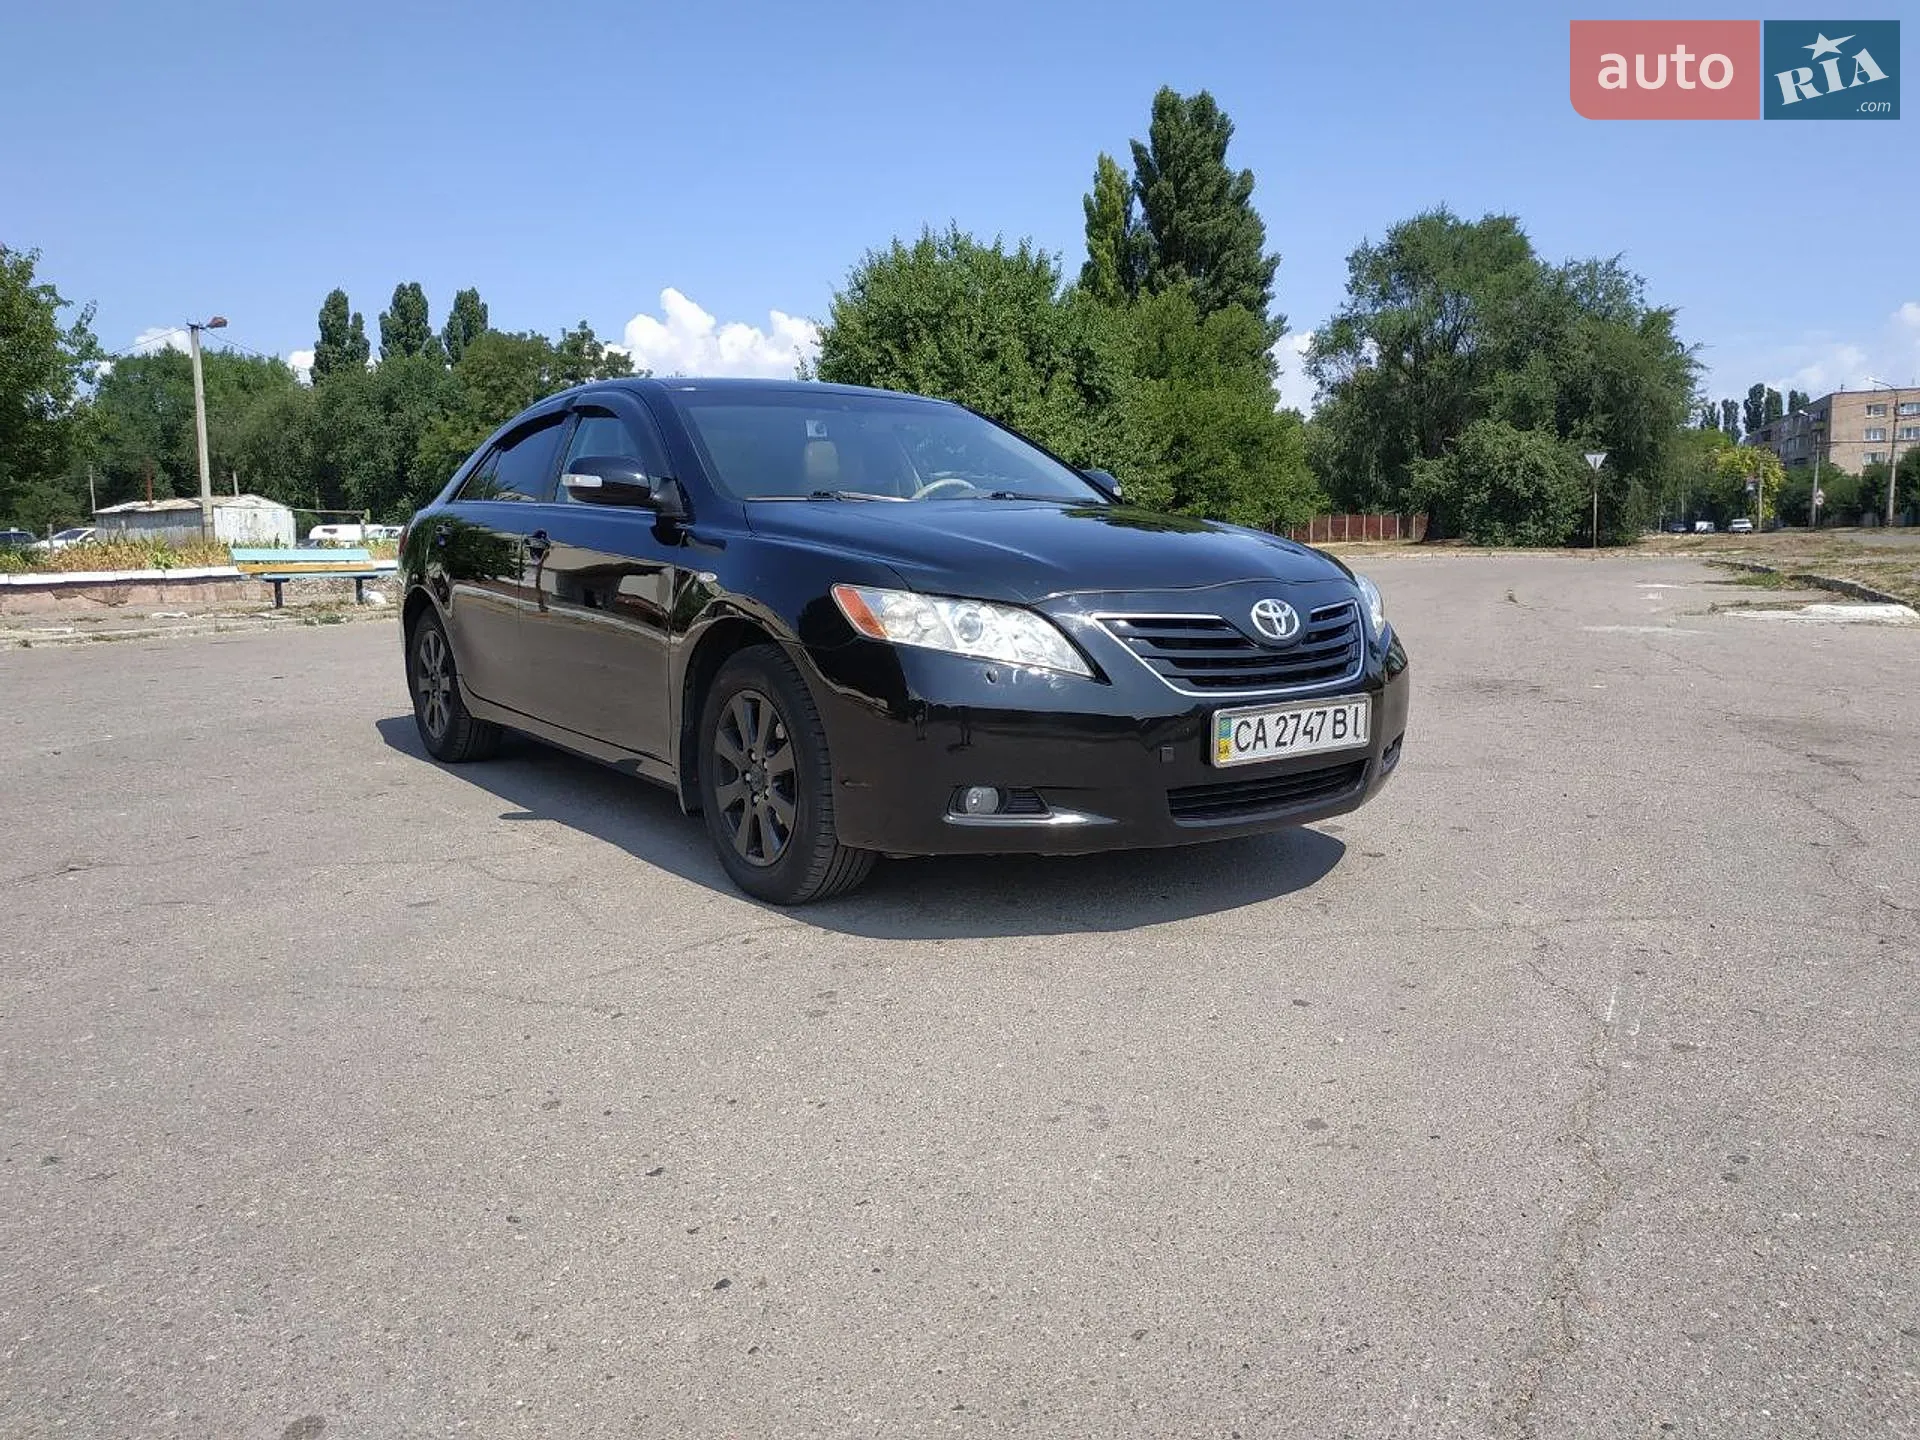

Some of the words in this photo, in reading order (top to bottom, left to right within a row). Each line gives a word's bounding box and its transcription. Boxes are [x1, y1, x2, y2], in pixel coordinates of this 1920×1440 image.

[1234, 717, 1268, 752] CA
[1274, 710, 1328, 748] 2747
[1332, 706, 1360, 740] BI
